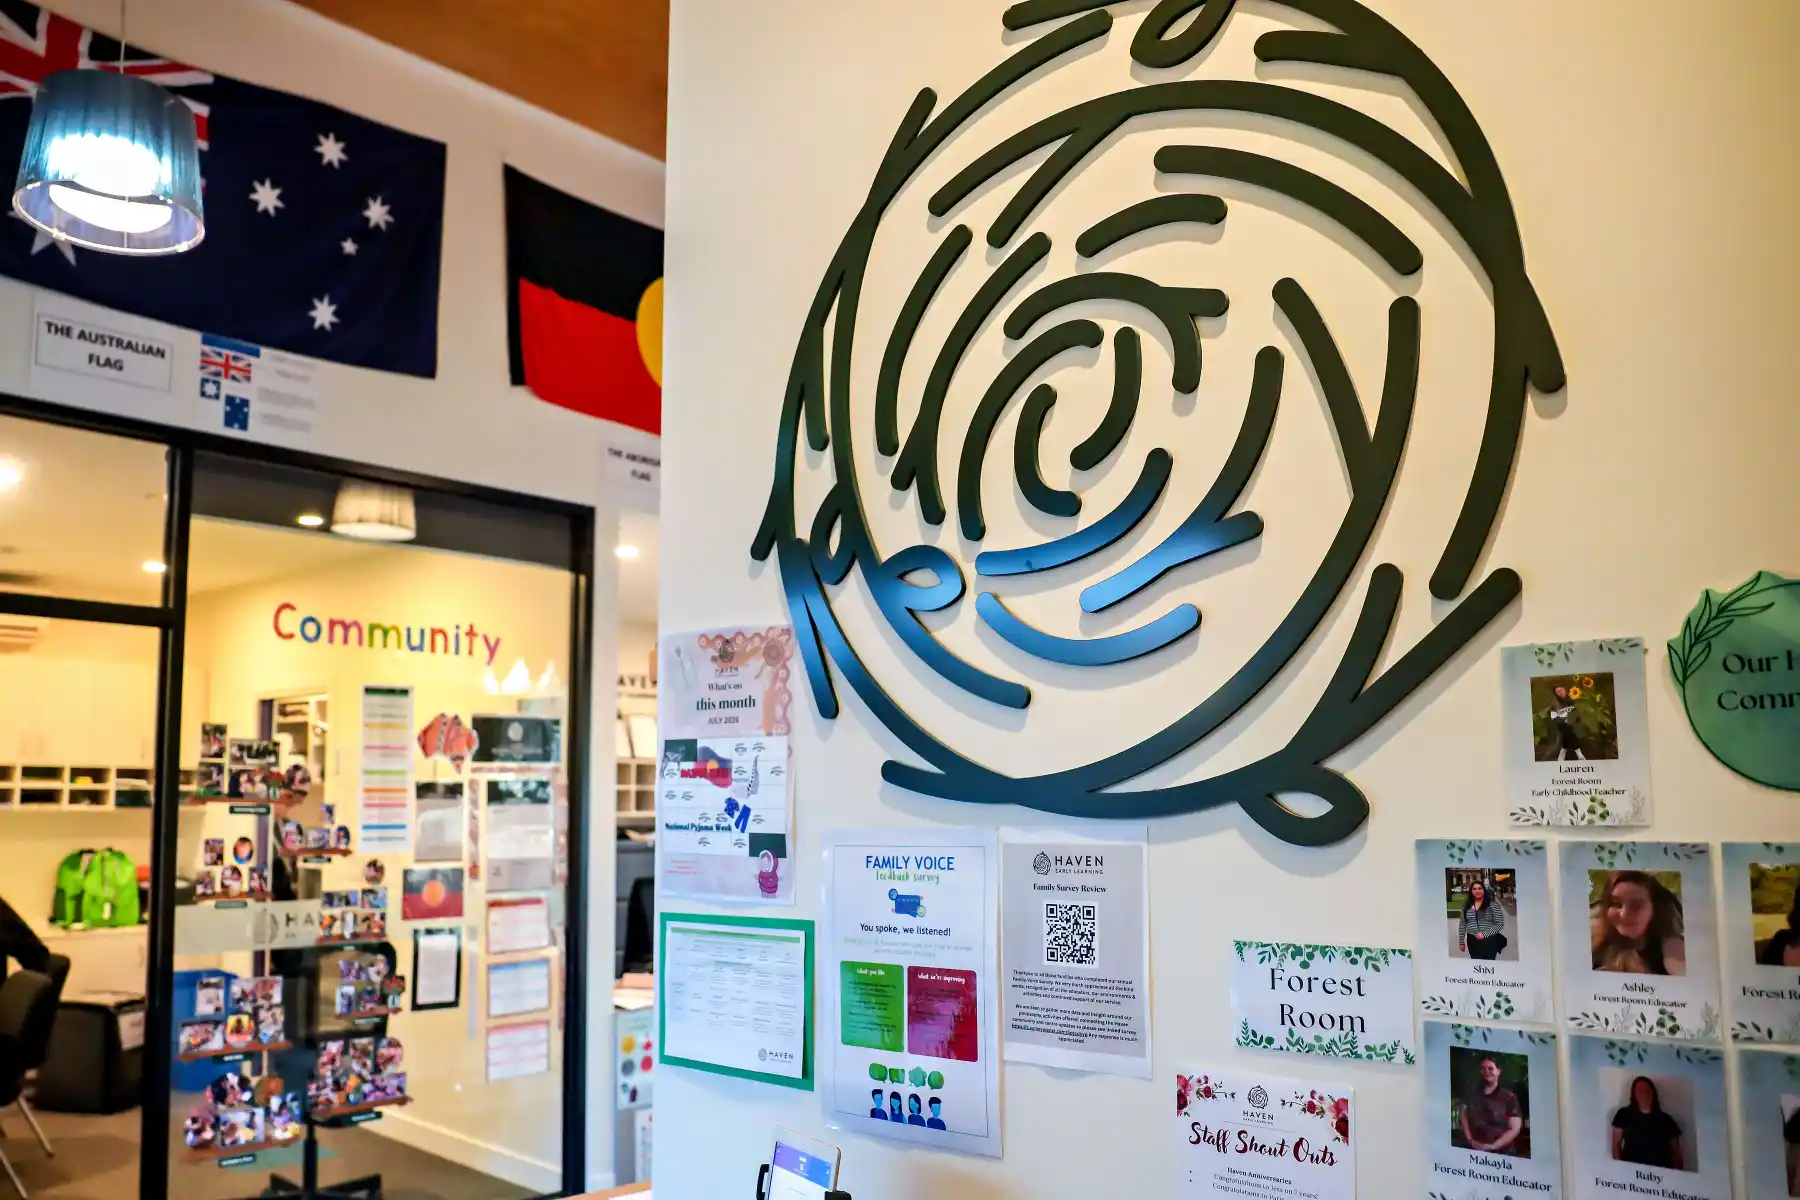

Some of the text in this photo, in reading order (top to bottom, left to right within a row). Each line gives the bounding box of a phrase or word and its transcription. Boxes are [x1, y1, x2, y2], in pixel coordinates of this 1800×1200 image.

[45, 321, 165, 359] THE AUSTRALIAN
[88, 353, 124, 372] FLAG
[273, 602, 502, 666] Community
[1722, 653, 1778, 674] Our
[708, 682, 731, 691] What's
[696, 694, 756, 711] this month
[1559, 765, 1594, 773] Lauren
[1577, 777, 1602, 785] Room
[1532, 787, 1626, 797] Early Childhood Teacher
[866, 855, 955, 870] FAMILY VOICE
[1055, 856, 1103, 867] HAVEN
[914, 873, 940, 885] survey
[1033, 883, 1107, 895] Family Survey Review
[860, 923, 874, 932] You
[875, 925, 900, 935] spoke,
[917, 928, 951, 936] listened!
[1270, 968, 1366, 997] Forest
[1444, 976, 1526, 989] Forest Room Educator
[1622, 982, 1656, 994] Ashley
[1742, 986, 1785, 999] Forest
[1594, 994, 1687, 1009] Forest Room Educator
[1279, 1003, 1366, 1033] Room
[769, 1051, 794, 1060] HAVEN
[1243, 1110, 1274, 1121] HAVEN
[1189, 1122, 1338, 1167] Staff Shout Outs
[1469, 1154, 1512, 1170] Makayla
[1214, 1173, 1261, 1189] Congratulations
[1227, 1167, 1292, 1185] Haven Anniversaries
[1434, 1162, 1552, 1192] Forest Room Educator
[1636, 1170, 1663, 1184] Ruby
[1212, 1183, 1260, 1198] Congratulations
[1595, 1177, 1627, 1190] Forest
[1629, 1183, 1660, 1197] Room
